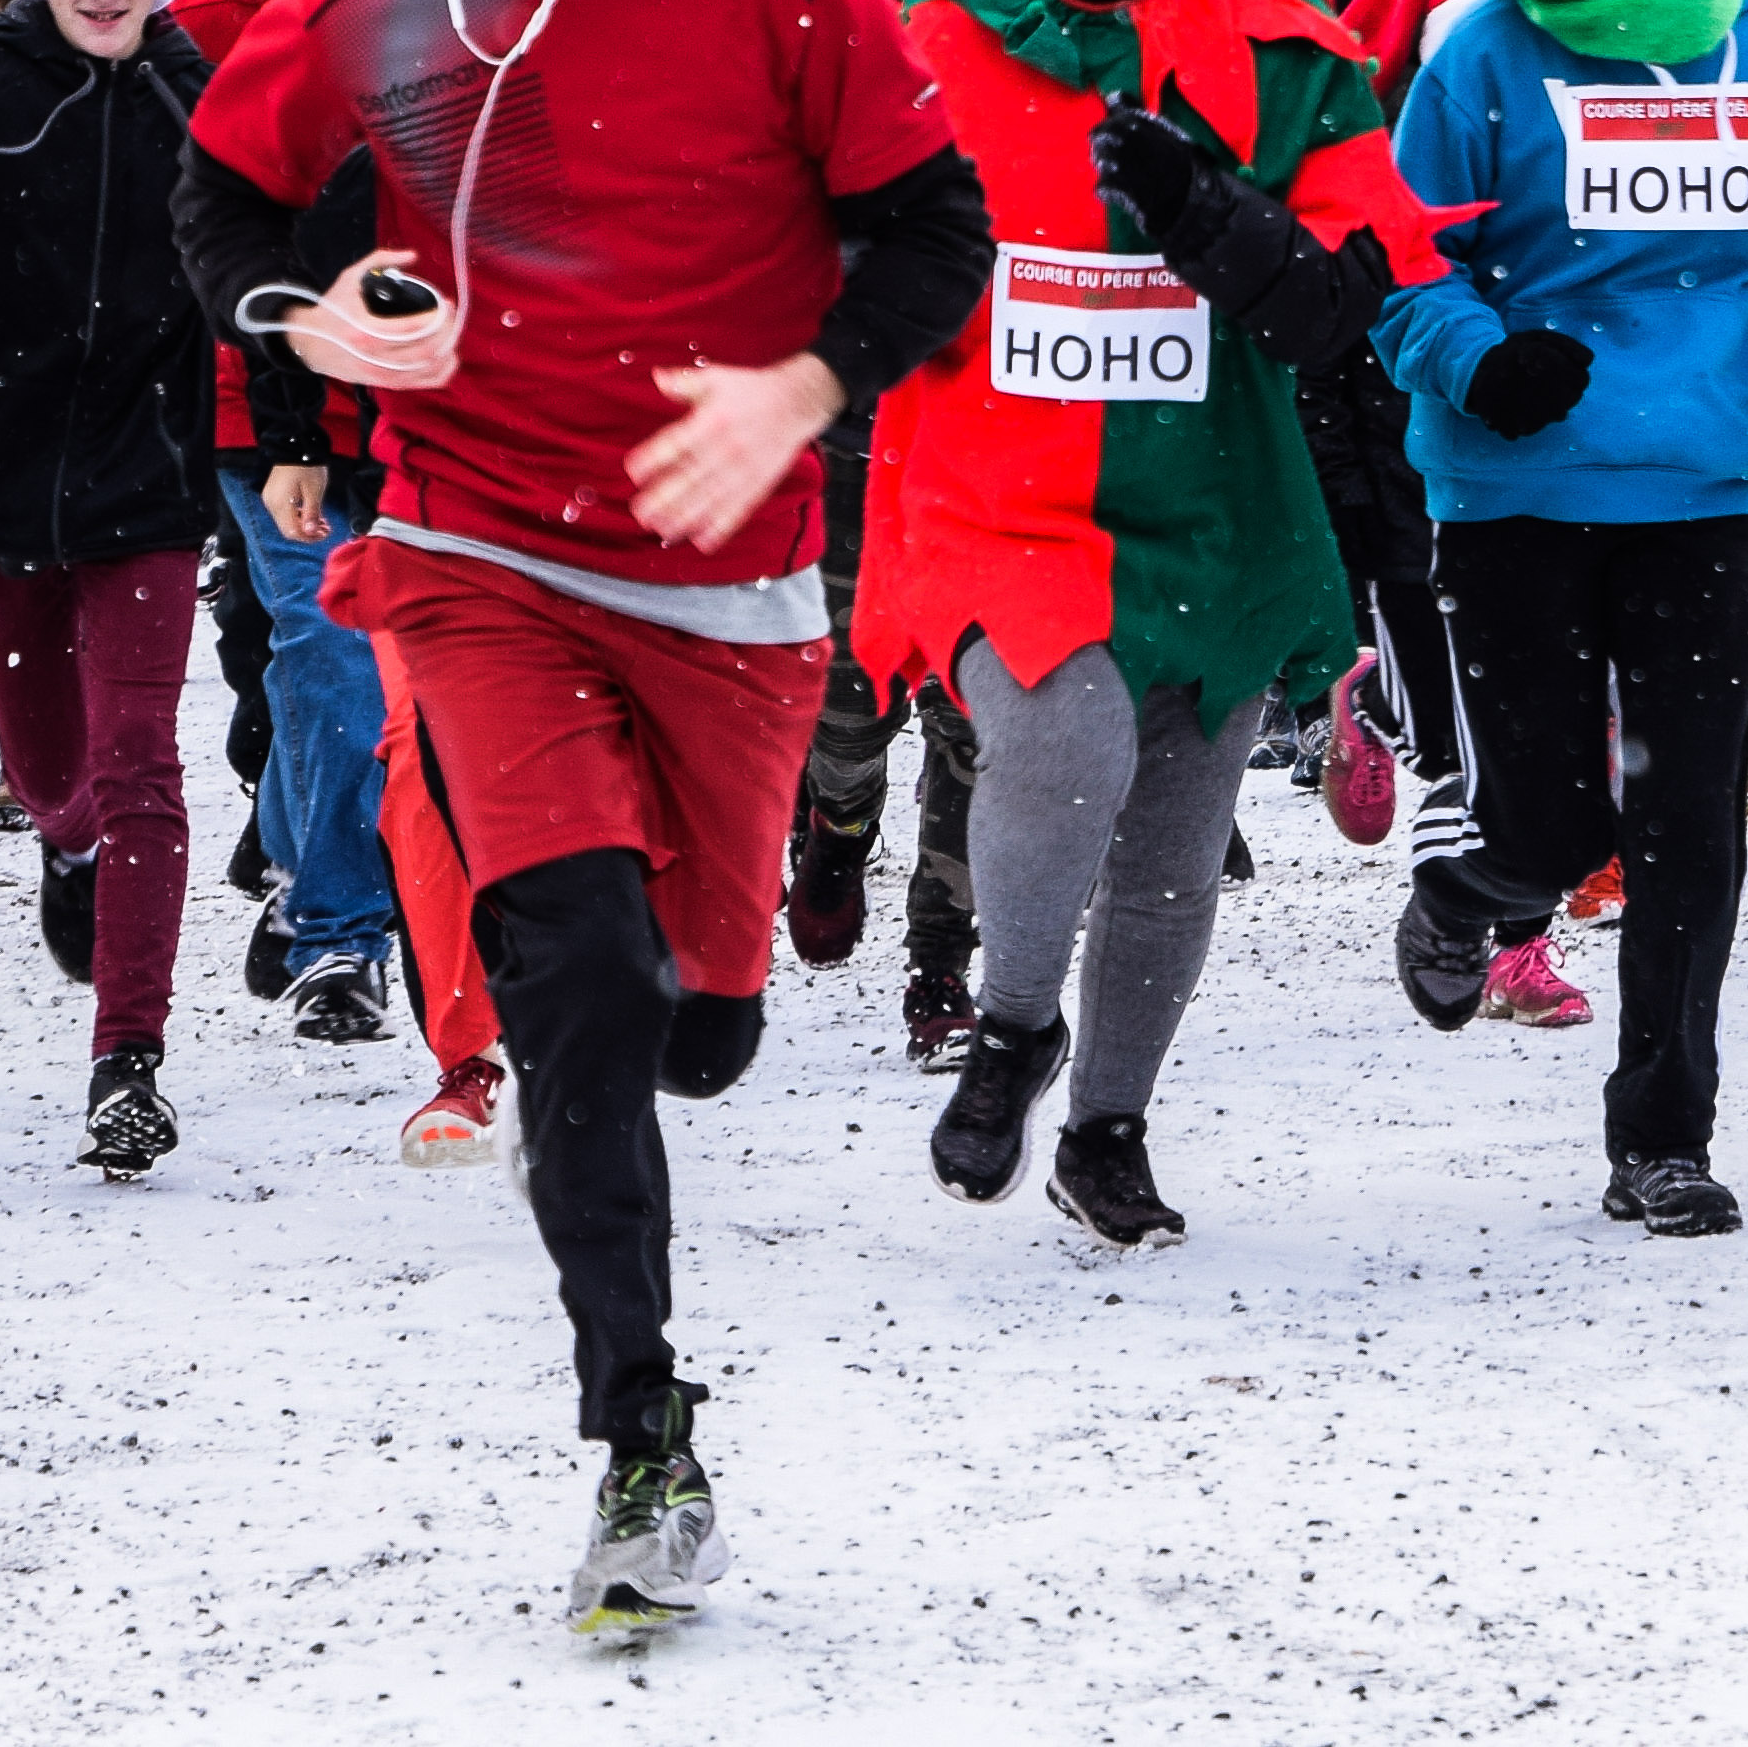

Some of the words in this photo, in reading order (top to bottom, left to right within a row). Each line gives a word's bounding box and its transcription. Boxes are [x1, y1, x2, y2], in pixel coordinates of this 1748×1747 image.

[1583, 103, 1646, 119] COURSE
[1647, 103, 1669, 119] DU
[1013, 261, 1073, 286] COURSE
[1076, 269, 1099, 289] DU
[1005, 328, 1193, 383] HOHO
